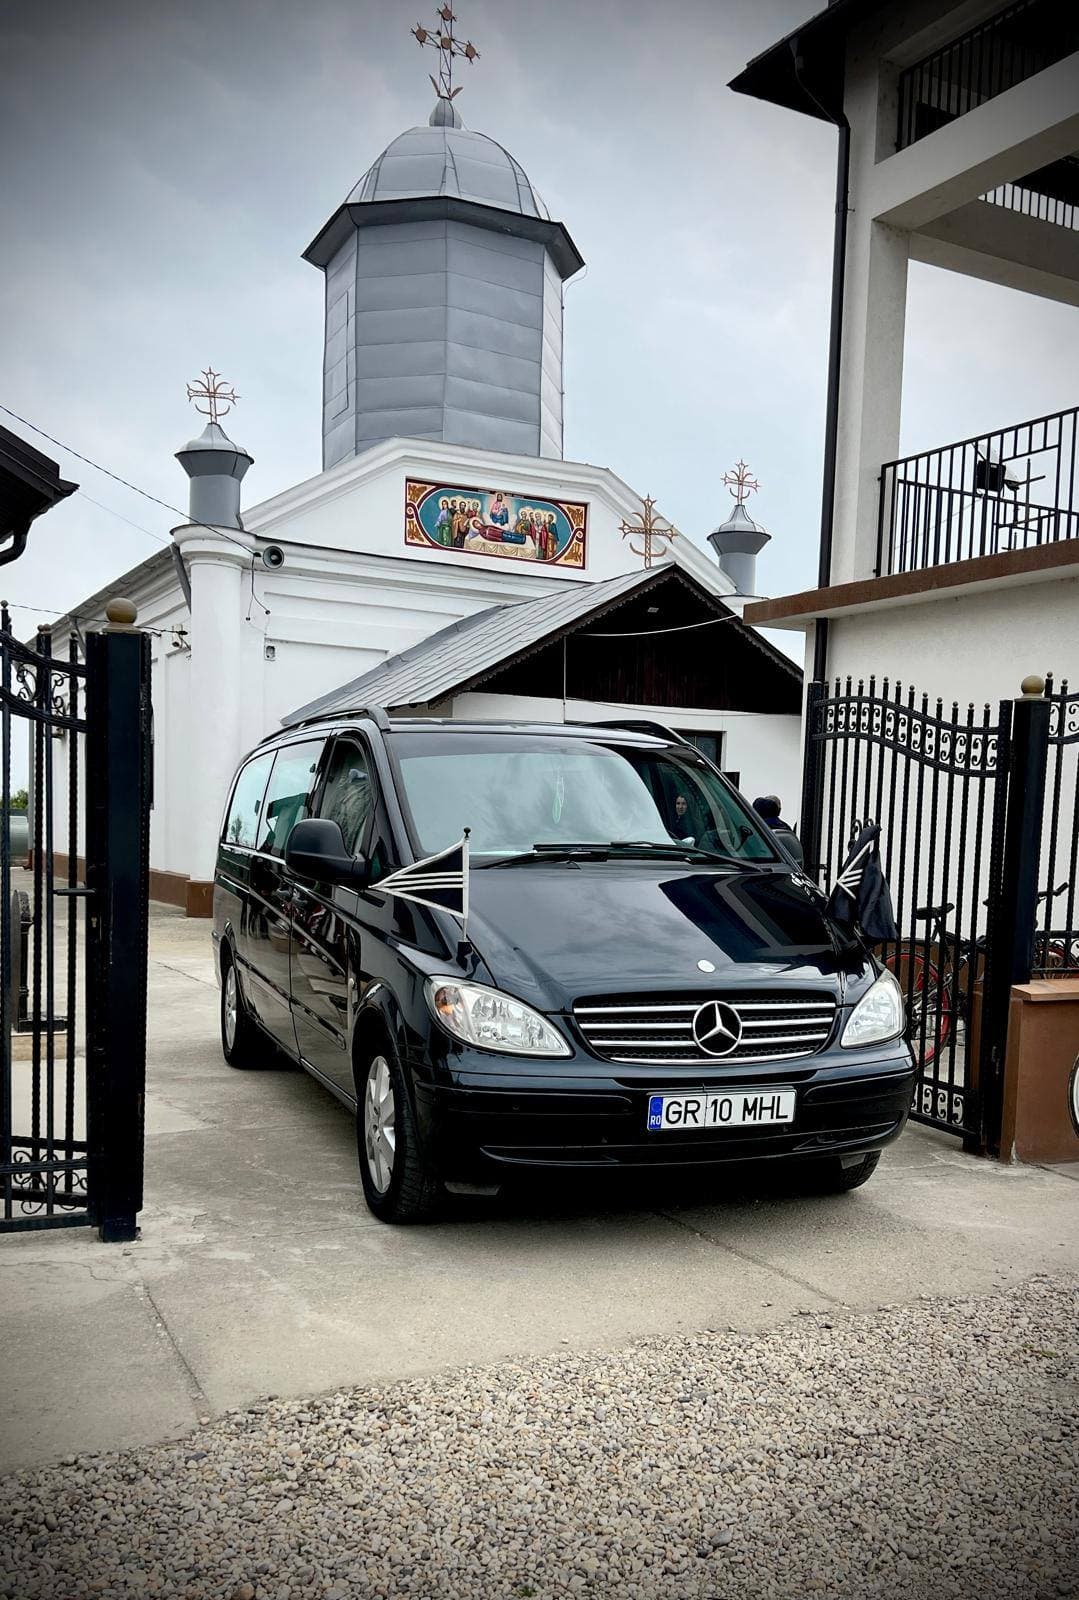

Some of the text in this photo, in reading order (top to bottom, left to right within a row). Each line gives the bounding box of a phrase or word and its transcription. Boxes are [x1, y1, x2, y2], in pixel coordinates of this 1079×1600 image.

[650, 1115, 661, 1125] RO
[665, 1095, 788, 1125] GR 10 MHL
